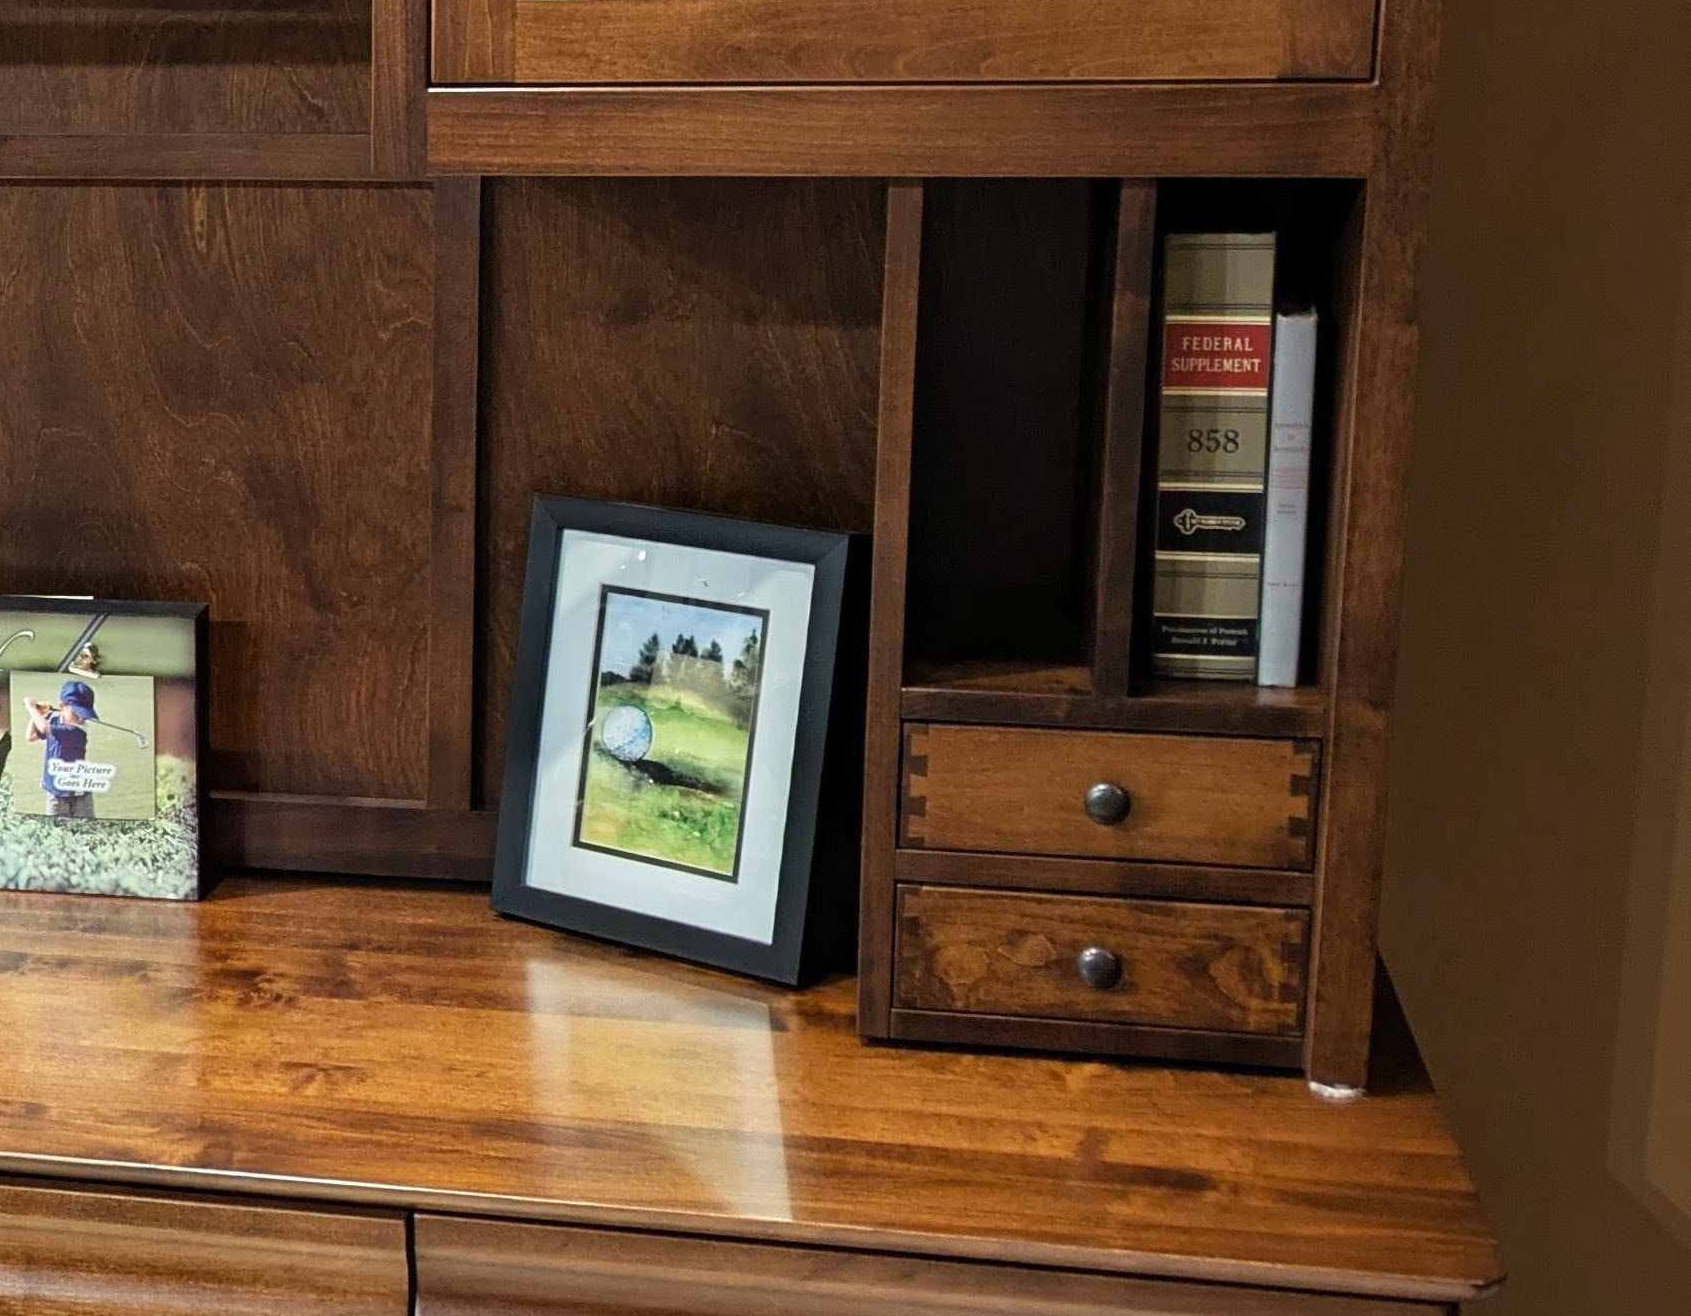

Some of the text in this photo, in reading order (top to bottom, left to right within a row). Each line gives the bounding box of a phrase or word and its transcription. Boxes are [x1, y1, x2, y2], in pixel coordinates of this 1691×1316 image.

[1182, 336, 1254, 352] FEDERAL
[1172, 357, 1261, 373] SUPPLEMENT
[1188, 428, 1240, 454] 858
[51, 762, 112, 775] Your Picture
[57, 777, 107, 789] Goes Here
